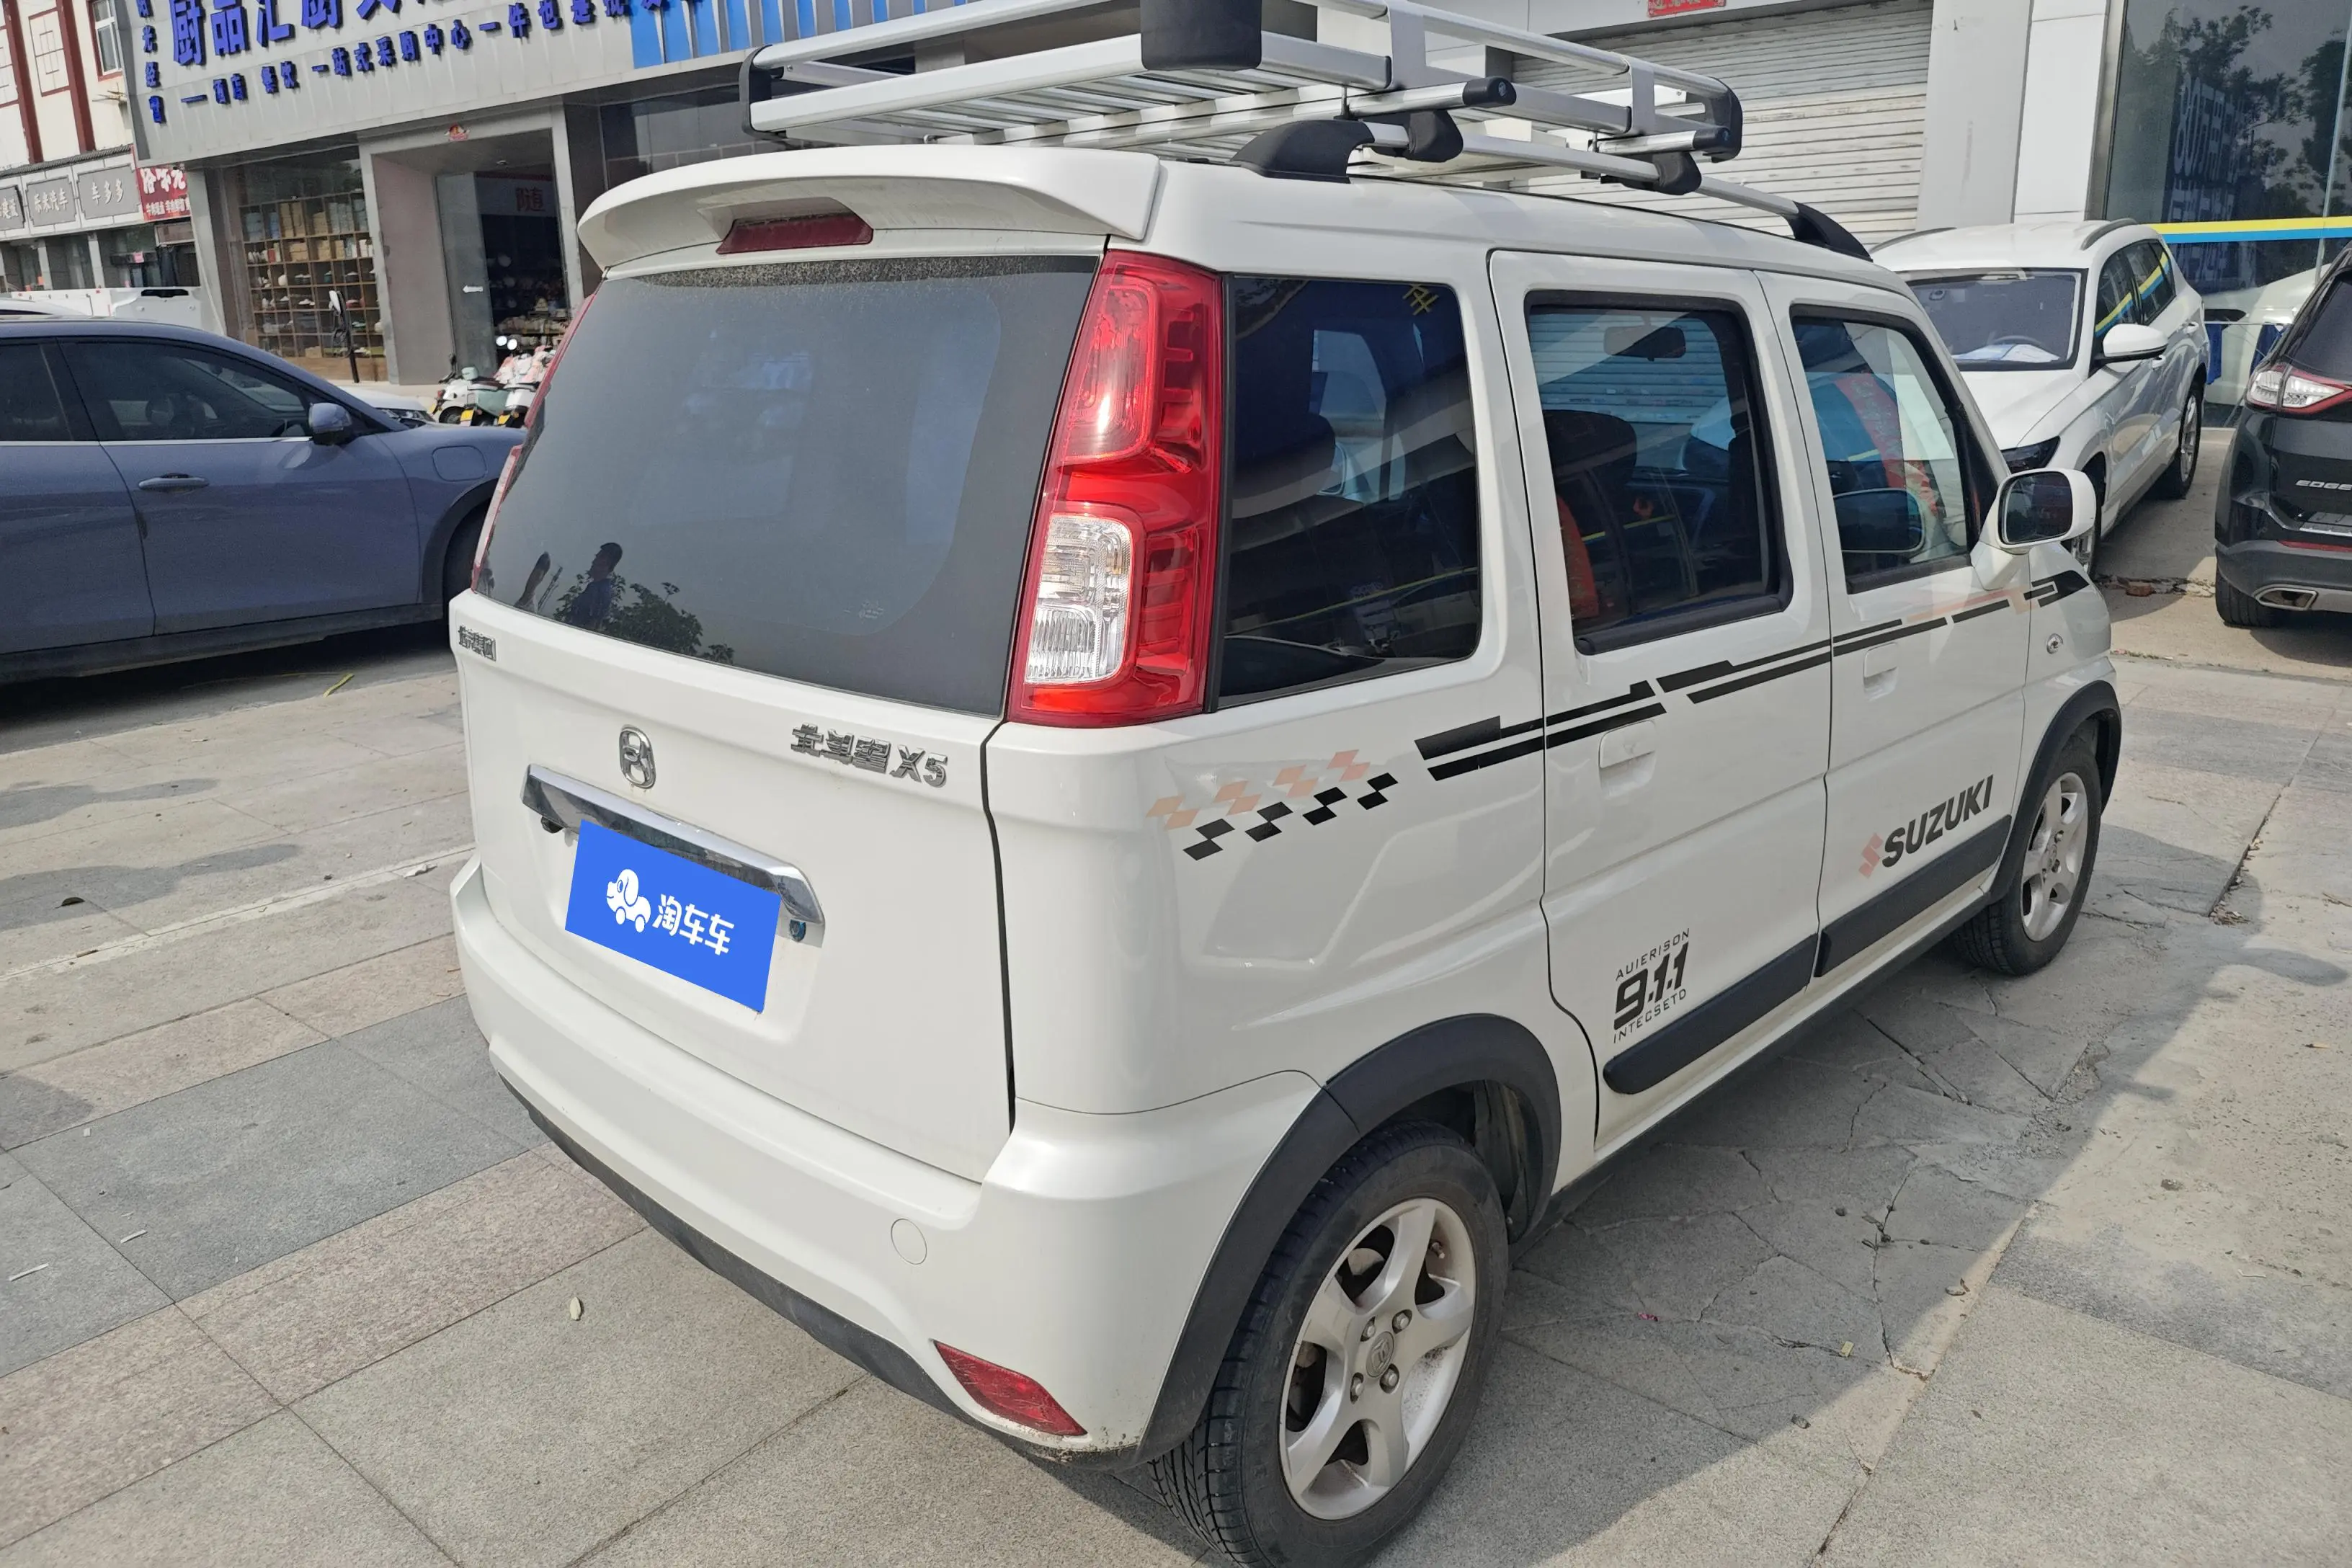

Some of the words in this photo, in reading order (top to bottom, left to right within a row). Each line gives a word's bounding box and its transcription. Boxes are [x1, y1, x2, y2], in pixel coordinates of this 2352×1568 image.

[2295, 479, 2352, 491] EDGE
[1881, 774, 1994, 868] SUZUKI
[1616, 927, 1690, 981] AUIERISON
